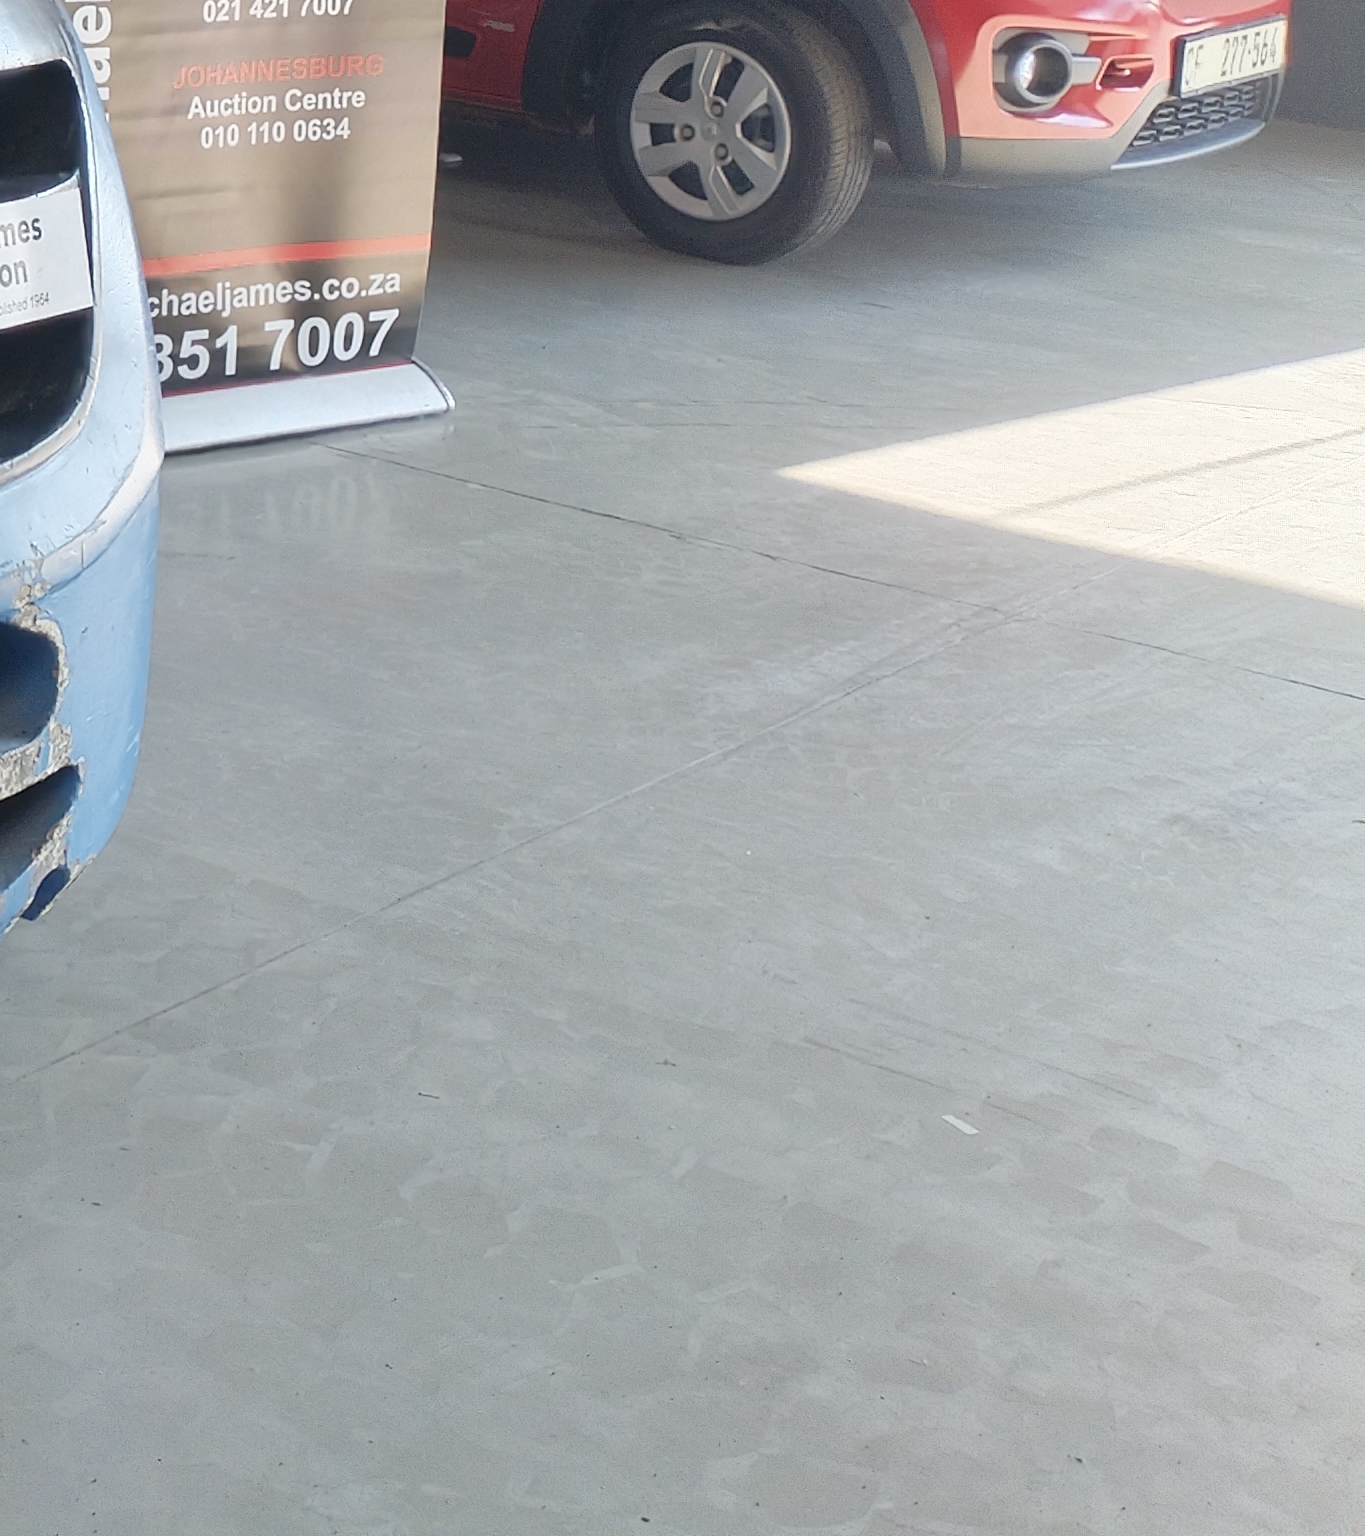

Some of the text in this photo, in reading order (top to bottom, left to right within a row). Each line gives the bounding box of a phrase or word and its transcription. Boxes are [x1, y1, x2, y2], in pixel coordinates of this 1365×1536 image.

[172, 53, 384, 90] JOHANNESBURG
[187, 87, 366, 120] Auction Centre
[201, 117, 351, 149] 010 110 0634
[148, 273, 401, 318] chaeljames.co.za
[264, 308, 400, 372] 7007
